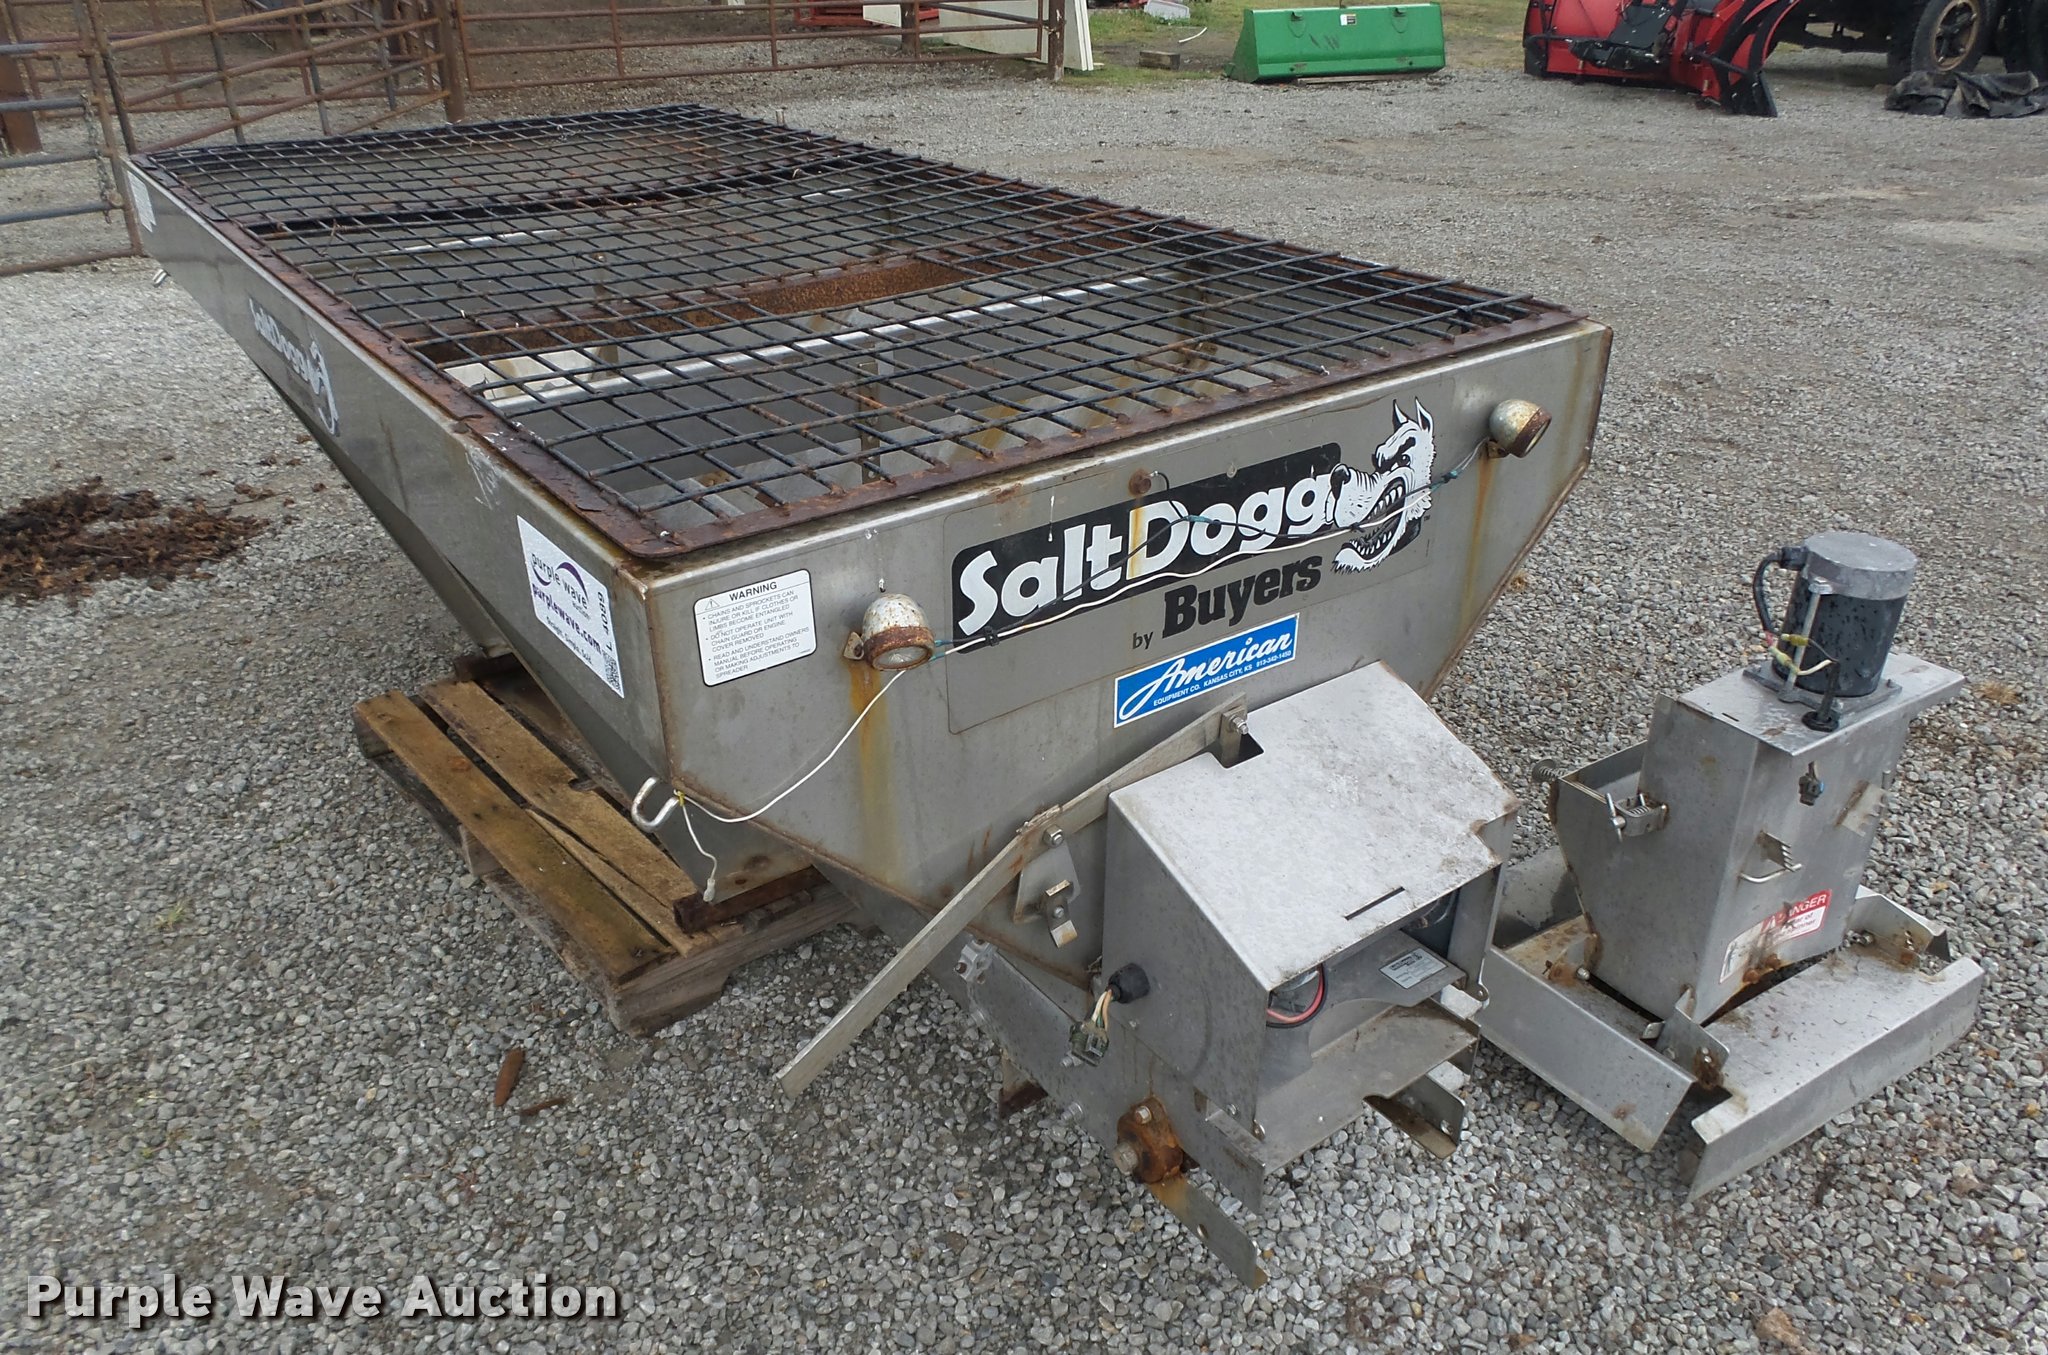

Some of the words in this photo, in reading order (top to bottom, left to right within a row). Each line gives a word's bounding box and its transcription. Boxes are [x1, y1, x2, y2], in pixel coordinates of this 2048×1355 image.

[957, 472, 1334, 637] SaltDogg
[531, 553, 561, 586] purple
[562, 578, 588, 610] wave
[729, 581, 777, 601] WARNING
[708, 608, 730, 619] CHAINS
[731, 604, 744, 612] AND
[745, 594, 781, 609] SPROCKETS
[782, 590, 794, 598] CAN
[709, 614, 731, 625] INJURE
[732, 611, 742, 619] OR
[742, 607, 754, 616] KILL
[762, 597, 788, 610] CLOTHES
[789, 594, 799, 602] OR
[1132, 630, 1154, 650] by
[1162, 555, 1323, 639] Buyers
[531, 582, 602, 655] purplewave.com
[710, 622, 727, 632] LIMBS
[729, 614, 753, 626] BECOME
[755, 604, 790, 619] ENTANGLED
[711, 632, 720, 640] DO
[721, 629, 734, 637] NOT
[735, 620, 761, 633] OPERATE
[764, 615, 777, 624] UNIT
[779, 610, 793, 619] WITH
[711, 637, 730, 647] CHAIN
[731, 630, 752, 640] GUARD
[764, 620, 785, 631] ENGINE
[712, 641, 733, 652] COVER
[735, 632, 764, 645] REMOVED
[714, 651, 730, 660] READ
[731, 647, 744, 656] AND
[745, 635, 784, 651] UNDERSTAND
[785, 626, 810, 639] OWNERS
[714, 655, 738, 666] MANUAL
[740, 648, 763, 660] BEFORE
[765, 637, 798, 651] OPERATING
[715, 665, 724, 673] OR
[725, 658, 749, 669] MAKING
[750, 644, 791, 661] ADJUSTMENTS
[716, 664, 748, 678] SPREADER
[1118, 632, 1293, 721] American
[1153, 687, 1190, 707] EQUIPMENT
[1190, 684, 1201, 693] CO.
[1203, 673, 1229, 687] KANSAS
[1229, 667, 1244, 678] CITY,
[1244, 664, 1253, 672] KS
